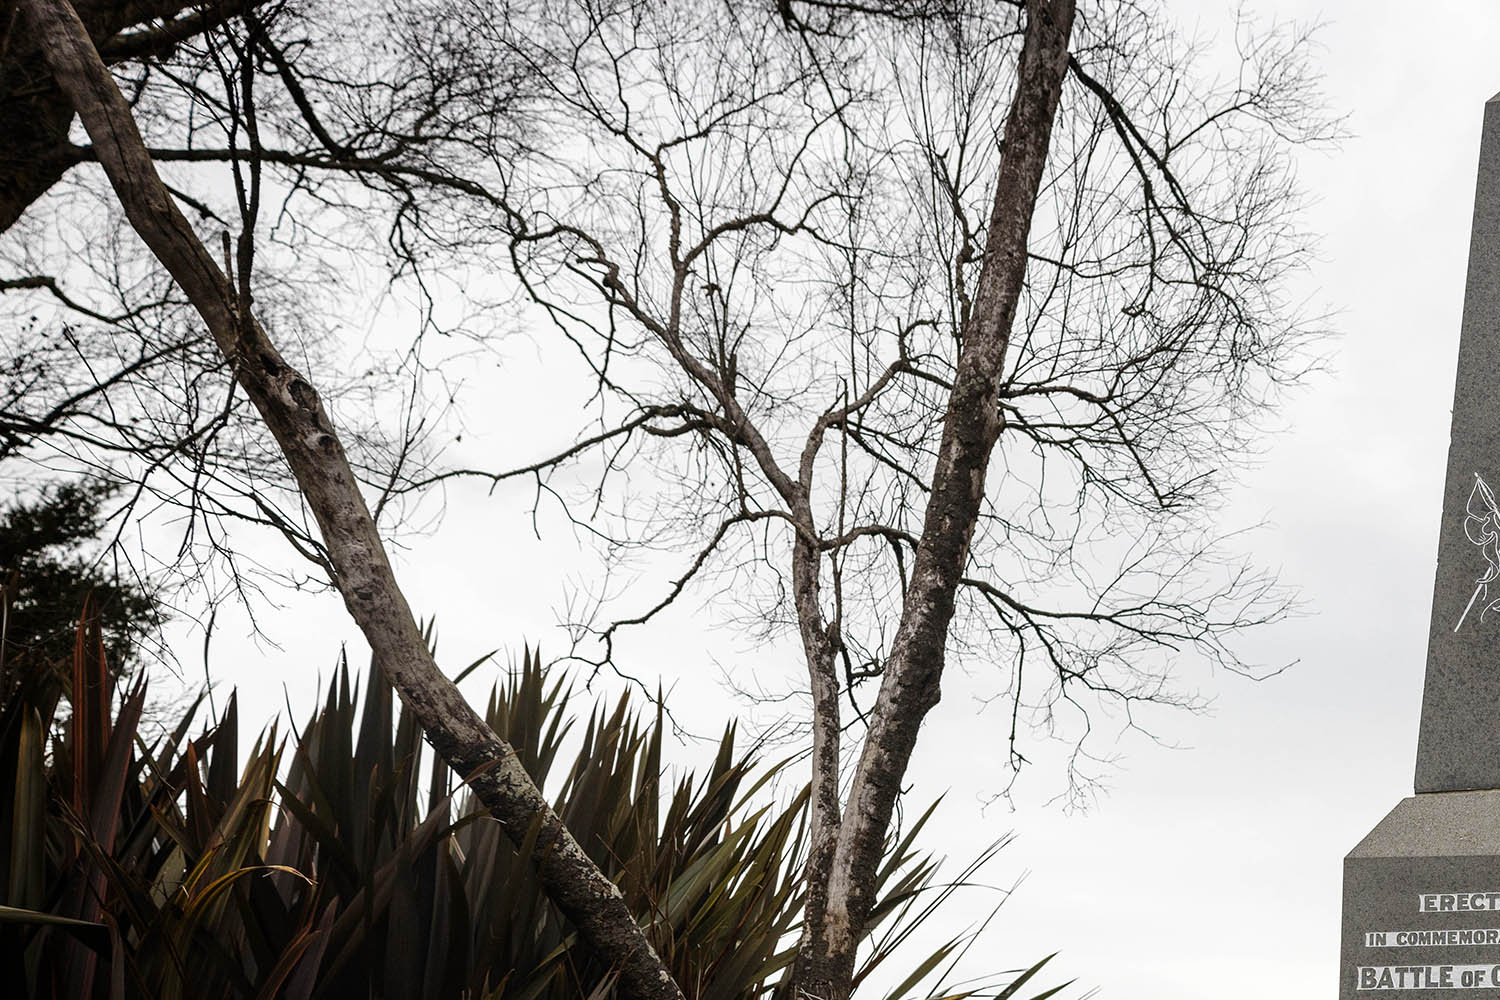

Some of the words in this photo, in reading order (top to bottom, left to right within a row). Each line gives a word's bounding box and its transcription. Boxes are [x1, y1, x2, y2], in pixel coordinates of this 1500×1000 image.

[1369, 932, 1387, 946] IN
[1361, 966, 1454, 989] BATTLE
[1461, 970, 1486, 987] OF
